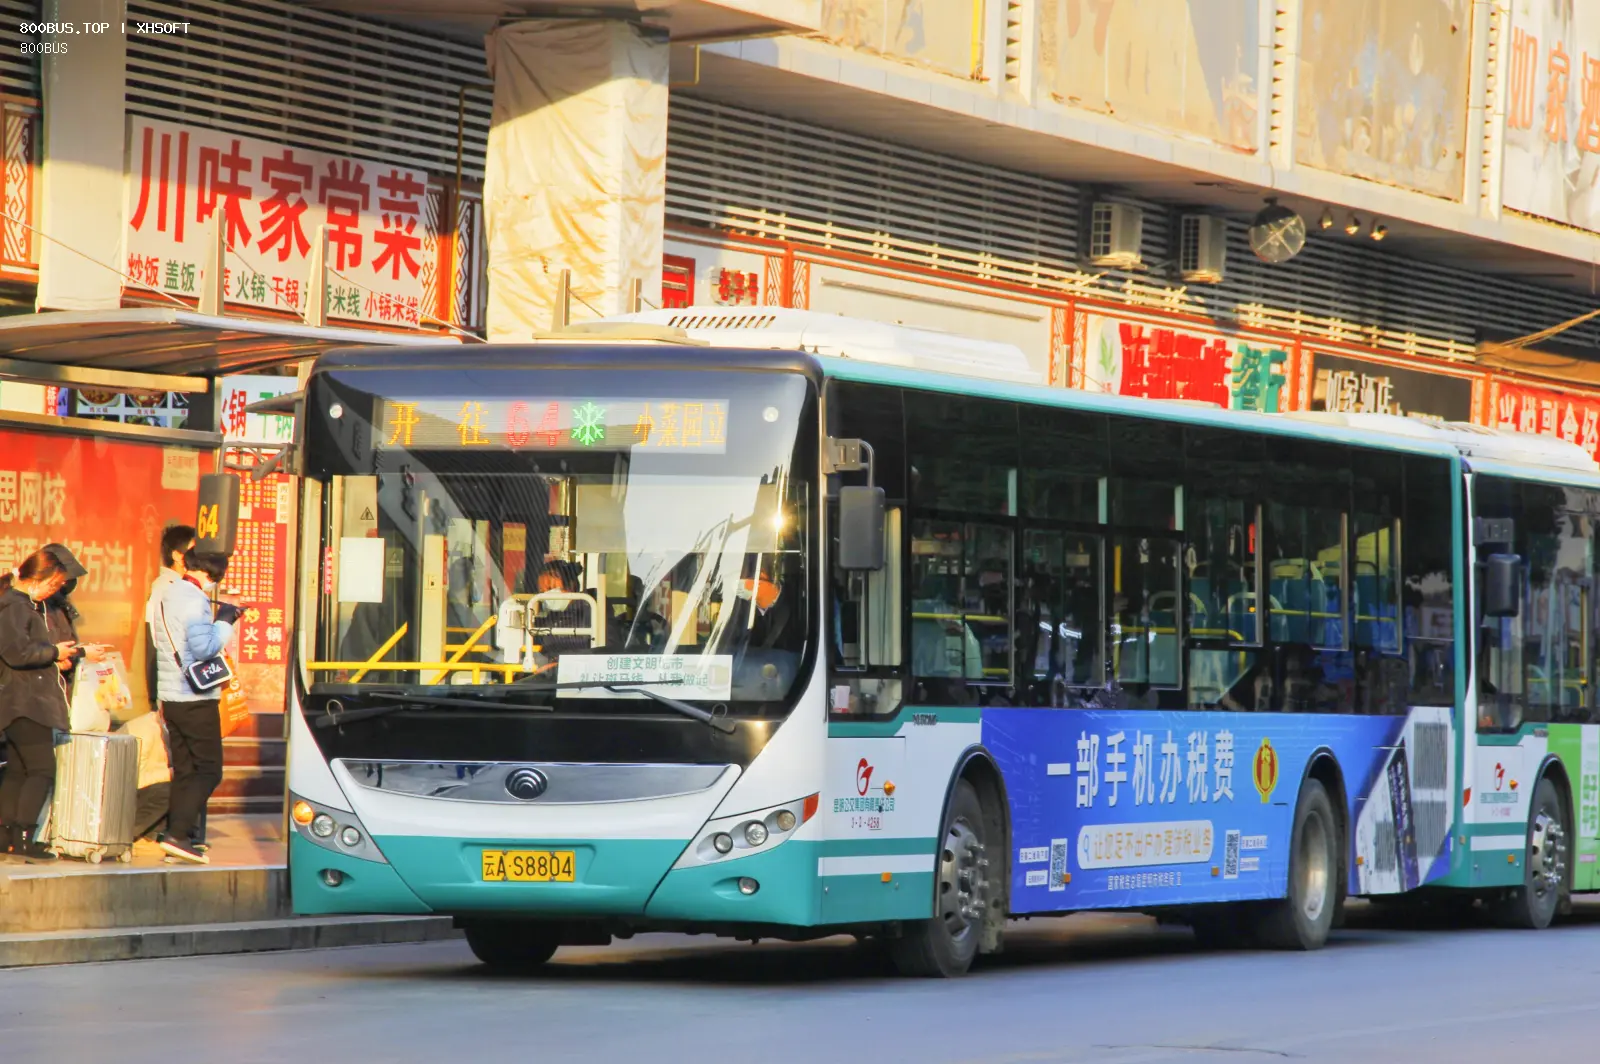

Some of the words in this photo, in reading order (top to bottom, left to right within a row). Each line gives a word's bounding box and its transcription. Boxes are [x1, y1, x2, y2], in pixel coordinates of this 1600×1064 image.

[130, 127, 427, 281] 川味家常菜
[128, 252, 159, 287] 炒饭
[164, 259, 196, 292] 盖饭
[235, 271, 266, 303] 火锅
[271, 276, 299, 308] 干锅
[365, 290, 419, 325] 小锅米线
[506, 402, 562, 446] 64
[633, 402, 725, 447] 小菜园立
[0, 470, 66, 525] 思网校
[198, 504, 218, 539] 64
[244, 607, 283, 625] 炒菜
[244, 626, 282, 642] 火锅
[242, 644, 282, 660] 干锅
[1047, 729, 1235, 808] 一部手机办税费
